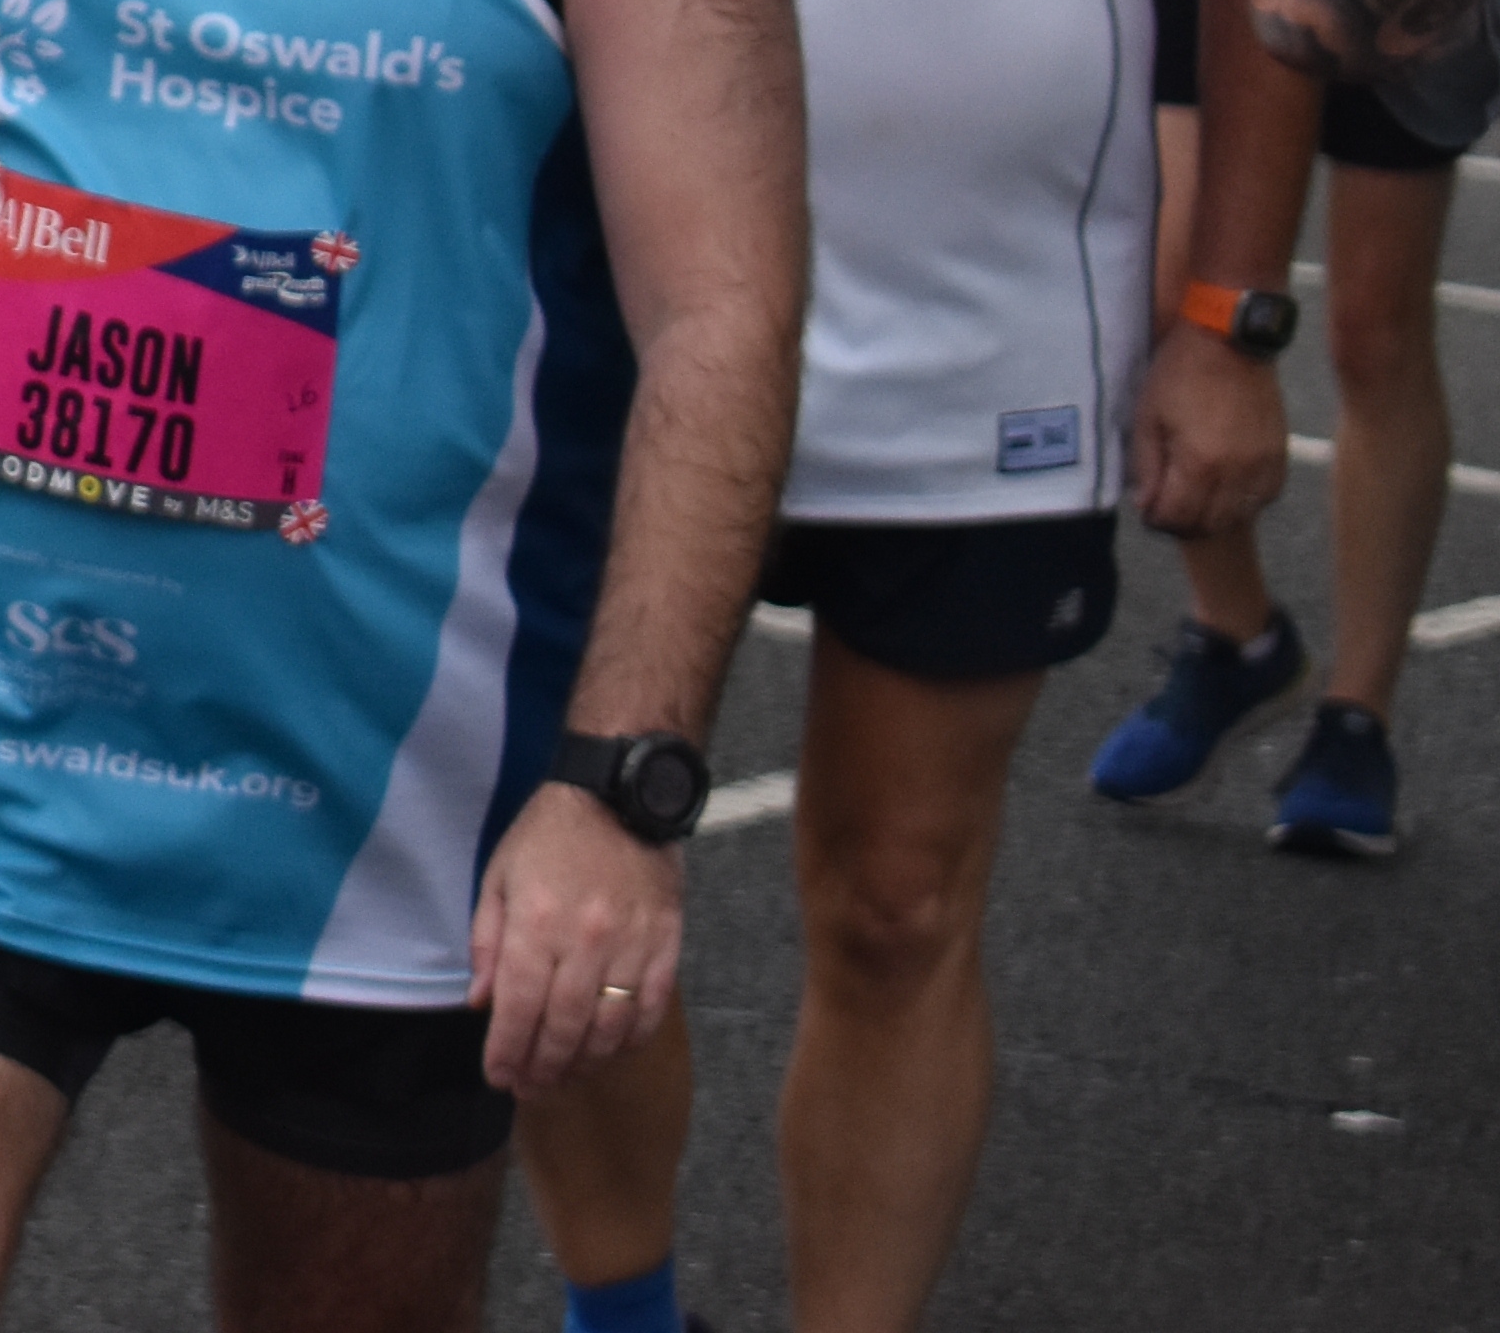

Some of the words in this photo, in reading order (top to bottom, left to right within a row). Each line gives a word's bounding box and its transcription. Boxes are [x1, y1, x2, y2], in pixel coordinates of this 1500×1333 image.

[108, 51, 345, 132] Hospice
[190, 11, 466, 93] Oswald's
[1, 199, 112, 263] AJBell
[26, 305, 204, 405] JASON
[15, 380, 196, 483] 38170
[196, 496, 255, 524] M&S
